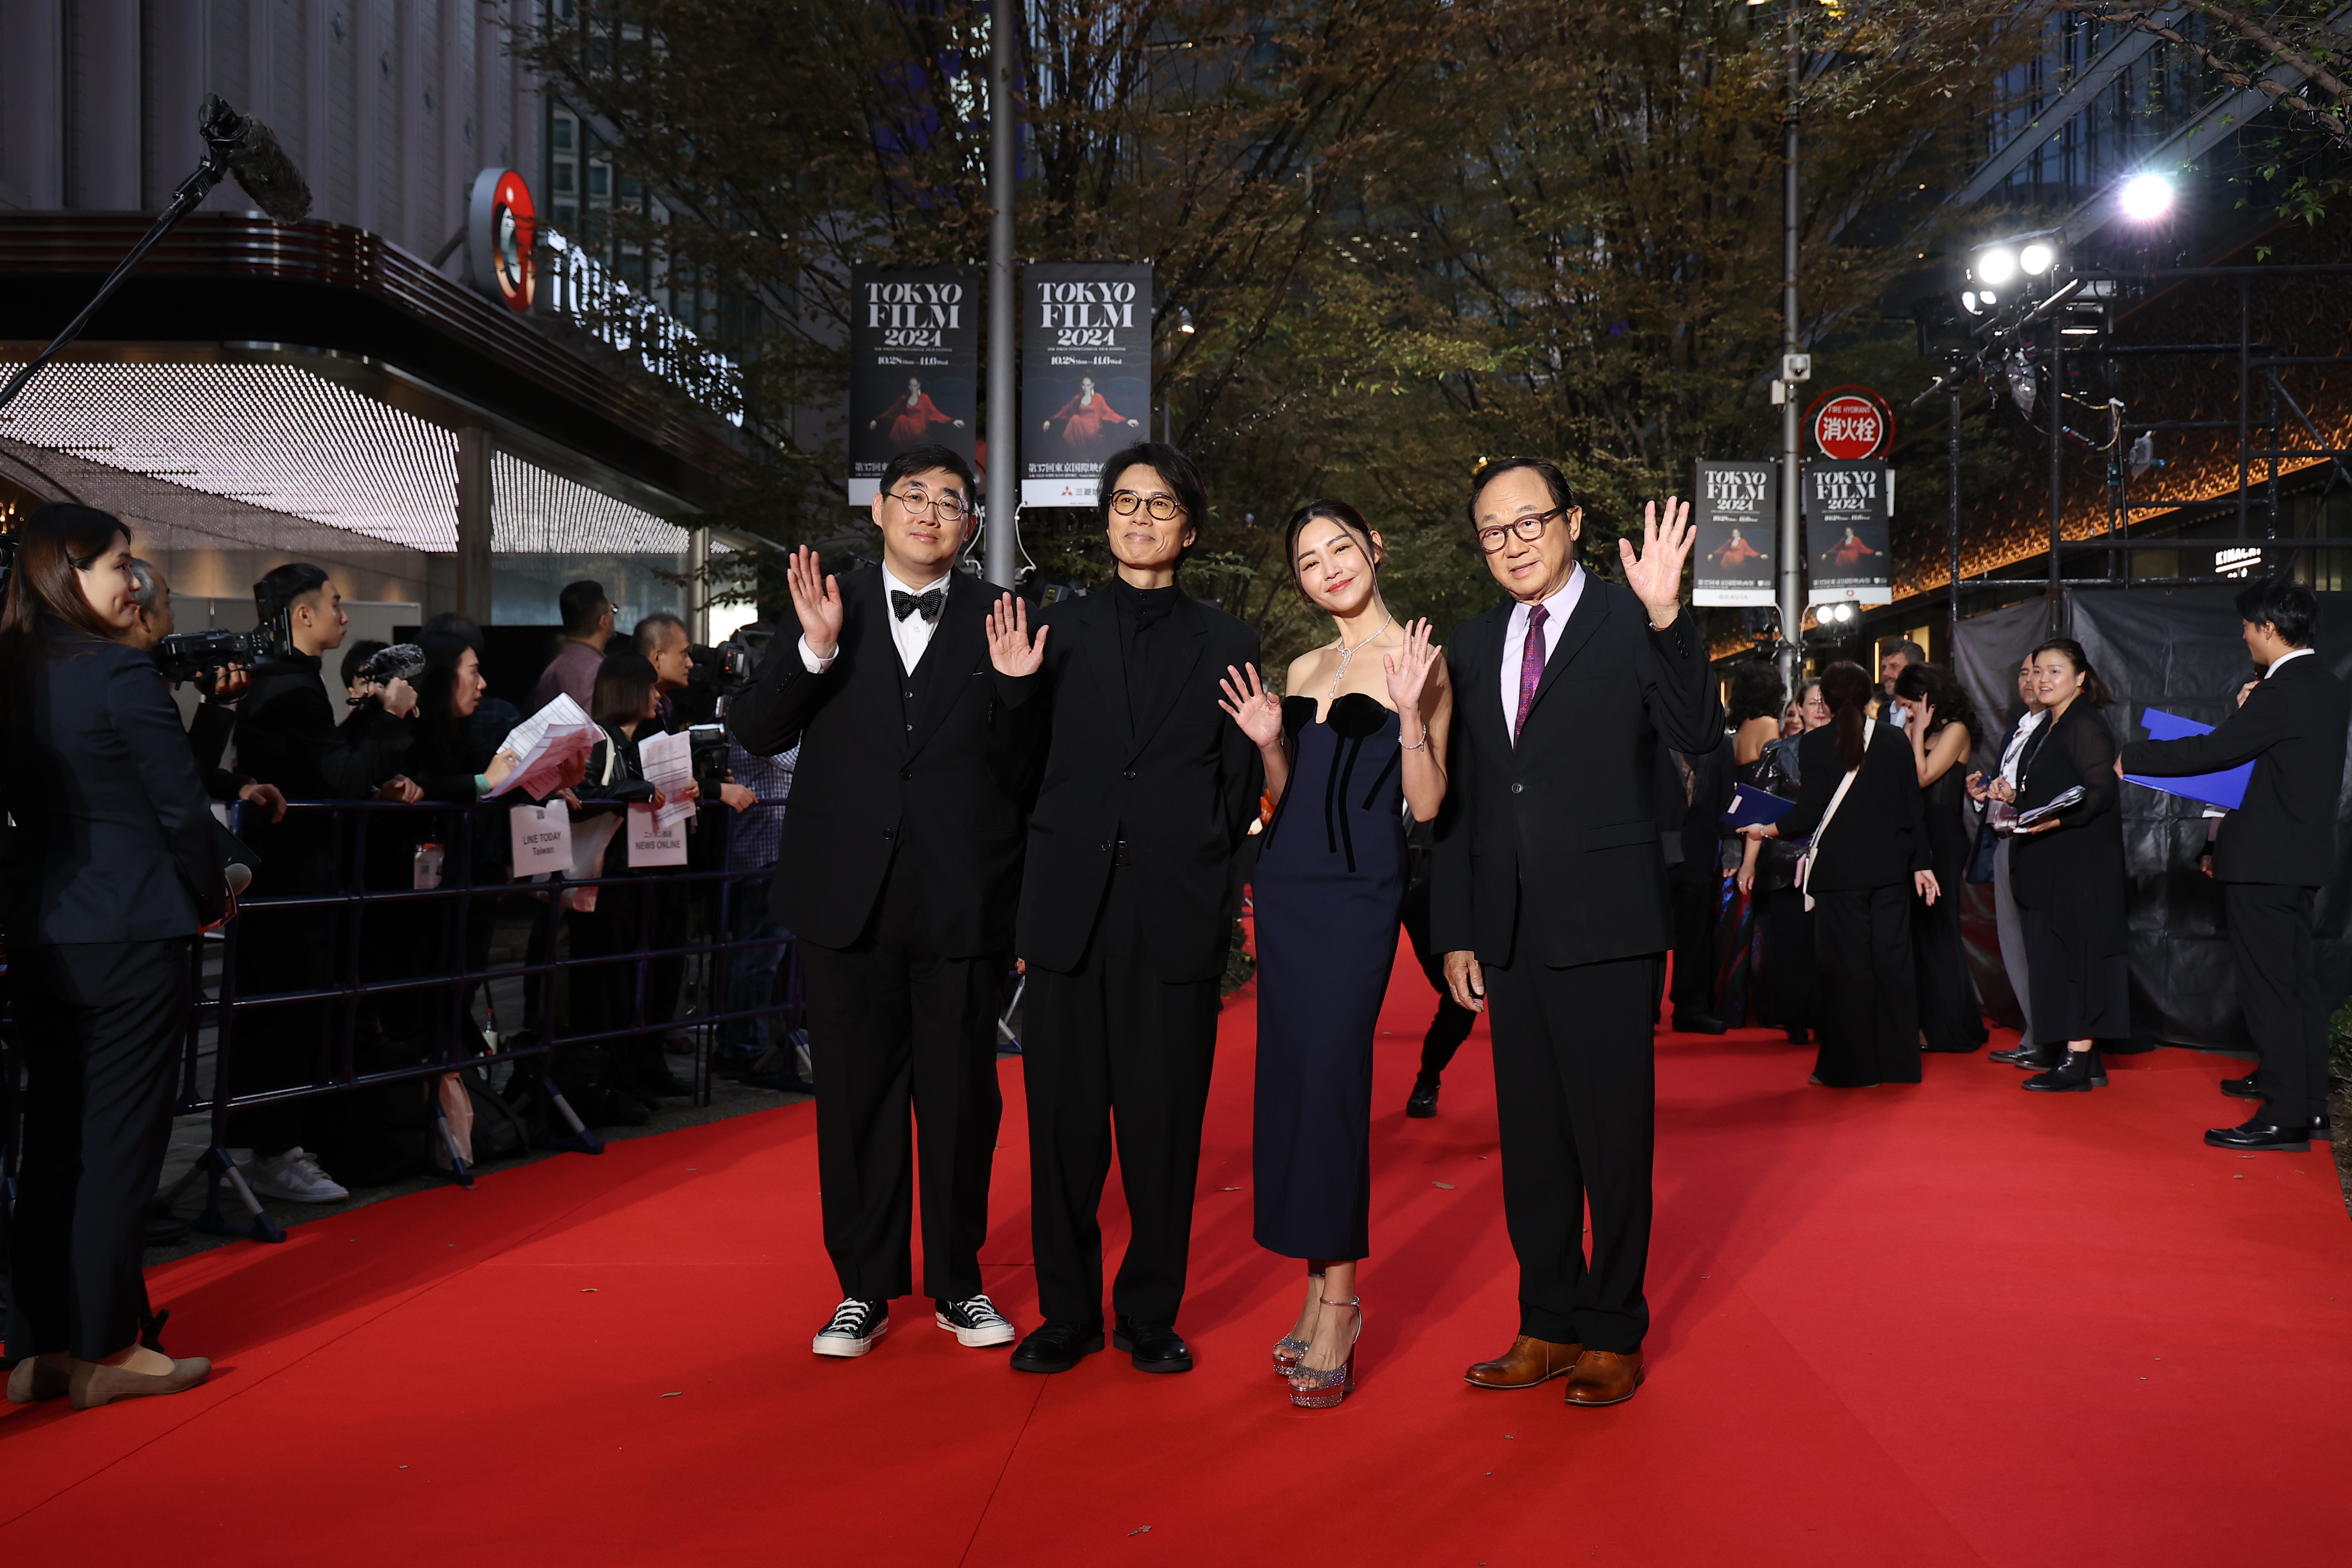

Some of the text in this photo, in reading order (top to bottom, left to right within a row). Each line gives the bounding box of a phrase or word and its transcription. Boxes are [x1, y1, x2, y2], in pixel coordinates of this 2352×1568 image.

[865, 282, 963, 304] TOKYO
[1037, 282, 1136, 303] TOKYO
[868, 303, 960, 329] FILM
[1041, 303, 1134, 328] FILM
[884, 329, 942, 346] 2024
[1057, 328, 1115, 346] 2024
[1822, 416, 1877, 442] 消火栓
[1704, 470, 1767, 485] TOKYO
[1813, 470, 1877, 484] TOKYO
[1706, 484, 1766, 500] FILM
[1816, 484, 1876, 500] FILM
[1716, 499, 1754, 511] 2024
[1827, 499, 1865, 510] 2024
[523, 831, 561, 845] LINE TODAY
[635, 840, 680, 850] NEWS ONLINE
[533, 846, 555, 856] Taiwan
